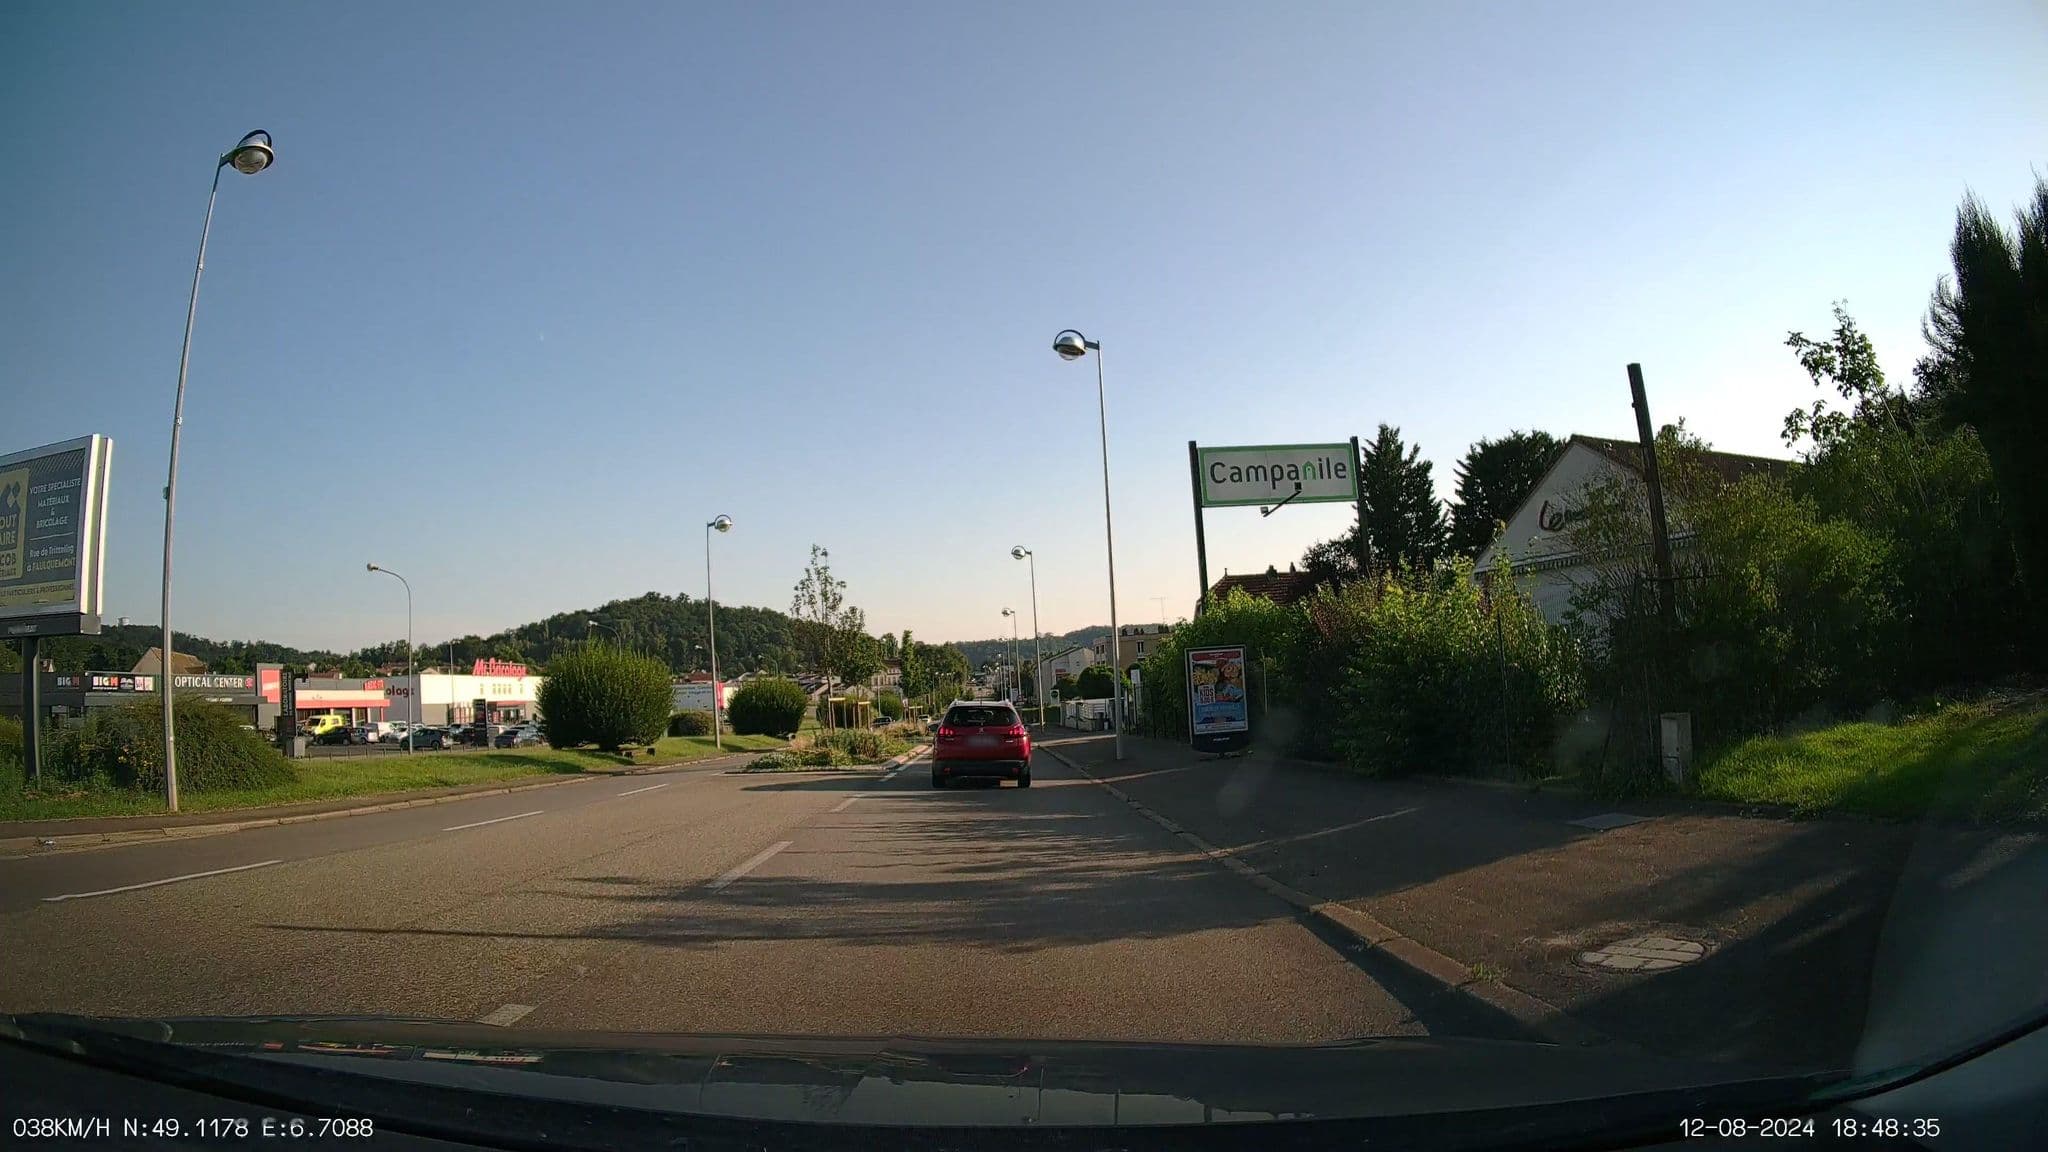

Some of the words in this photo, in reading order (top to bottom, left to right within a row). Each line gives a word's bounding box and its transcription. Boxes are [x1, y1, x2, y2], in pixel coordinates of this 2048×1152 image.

[1210, 457, 1347, 489] Campanile
[174, 676, 211, 688] OPTICAL
[214, 677, 243, 688] CENTER
